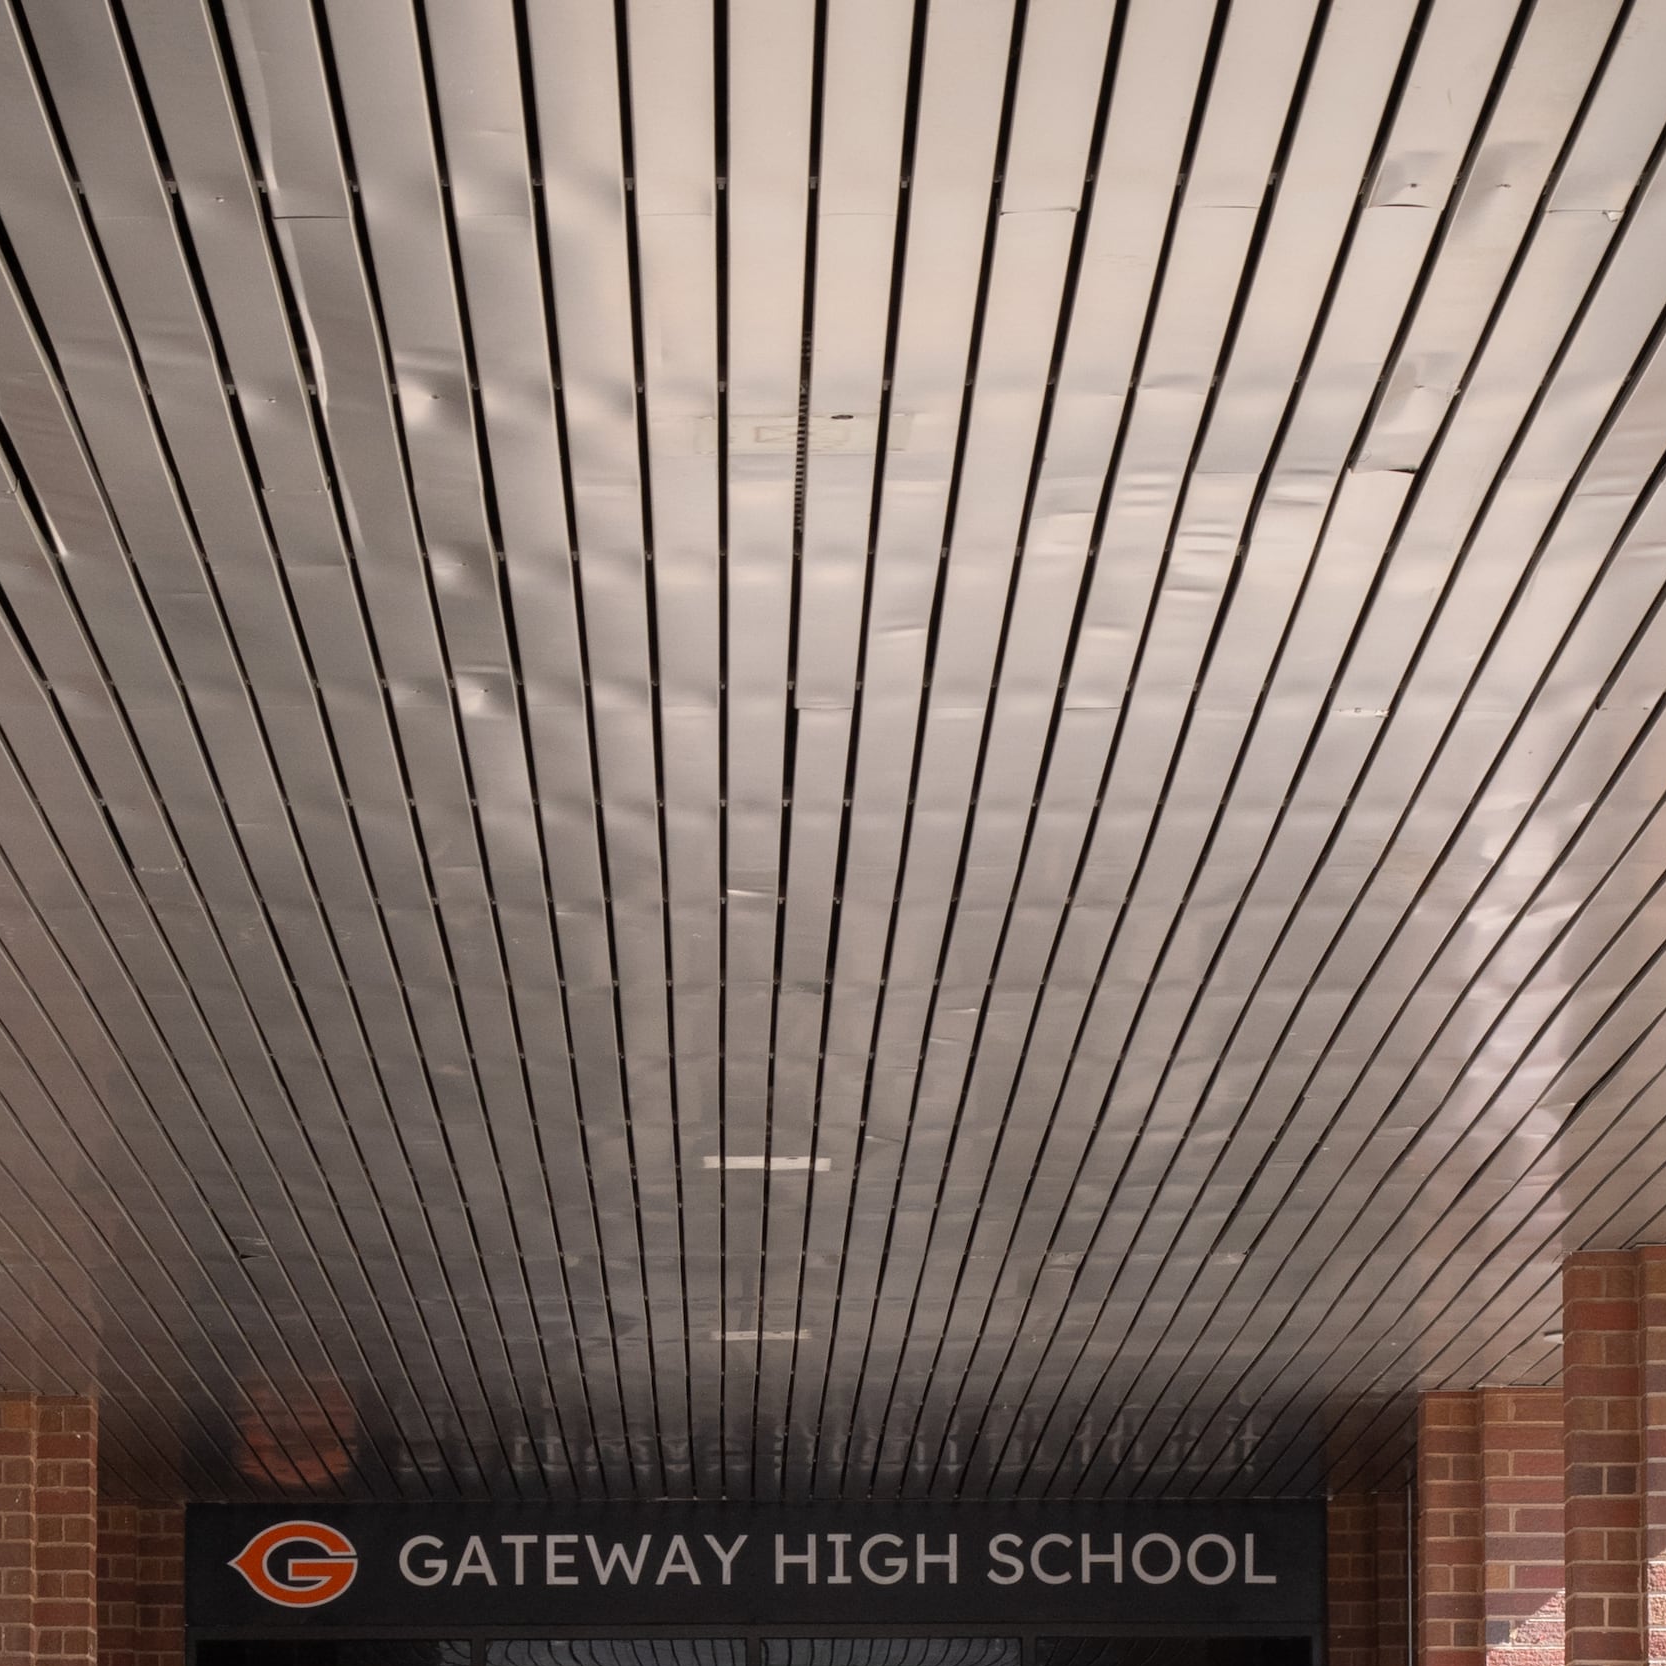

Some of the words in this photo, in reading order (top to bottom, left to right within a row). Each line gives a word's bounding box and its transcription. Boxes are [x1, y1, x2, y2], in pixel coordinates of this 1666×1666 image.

[398, 1534, 748, 1586] GATEWAY
[775, 1533, 958, 1585] HIGH
[986, 1532, 1277, 1586] SCHOOL
